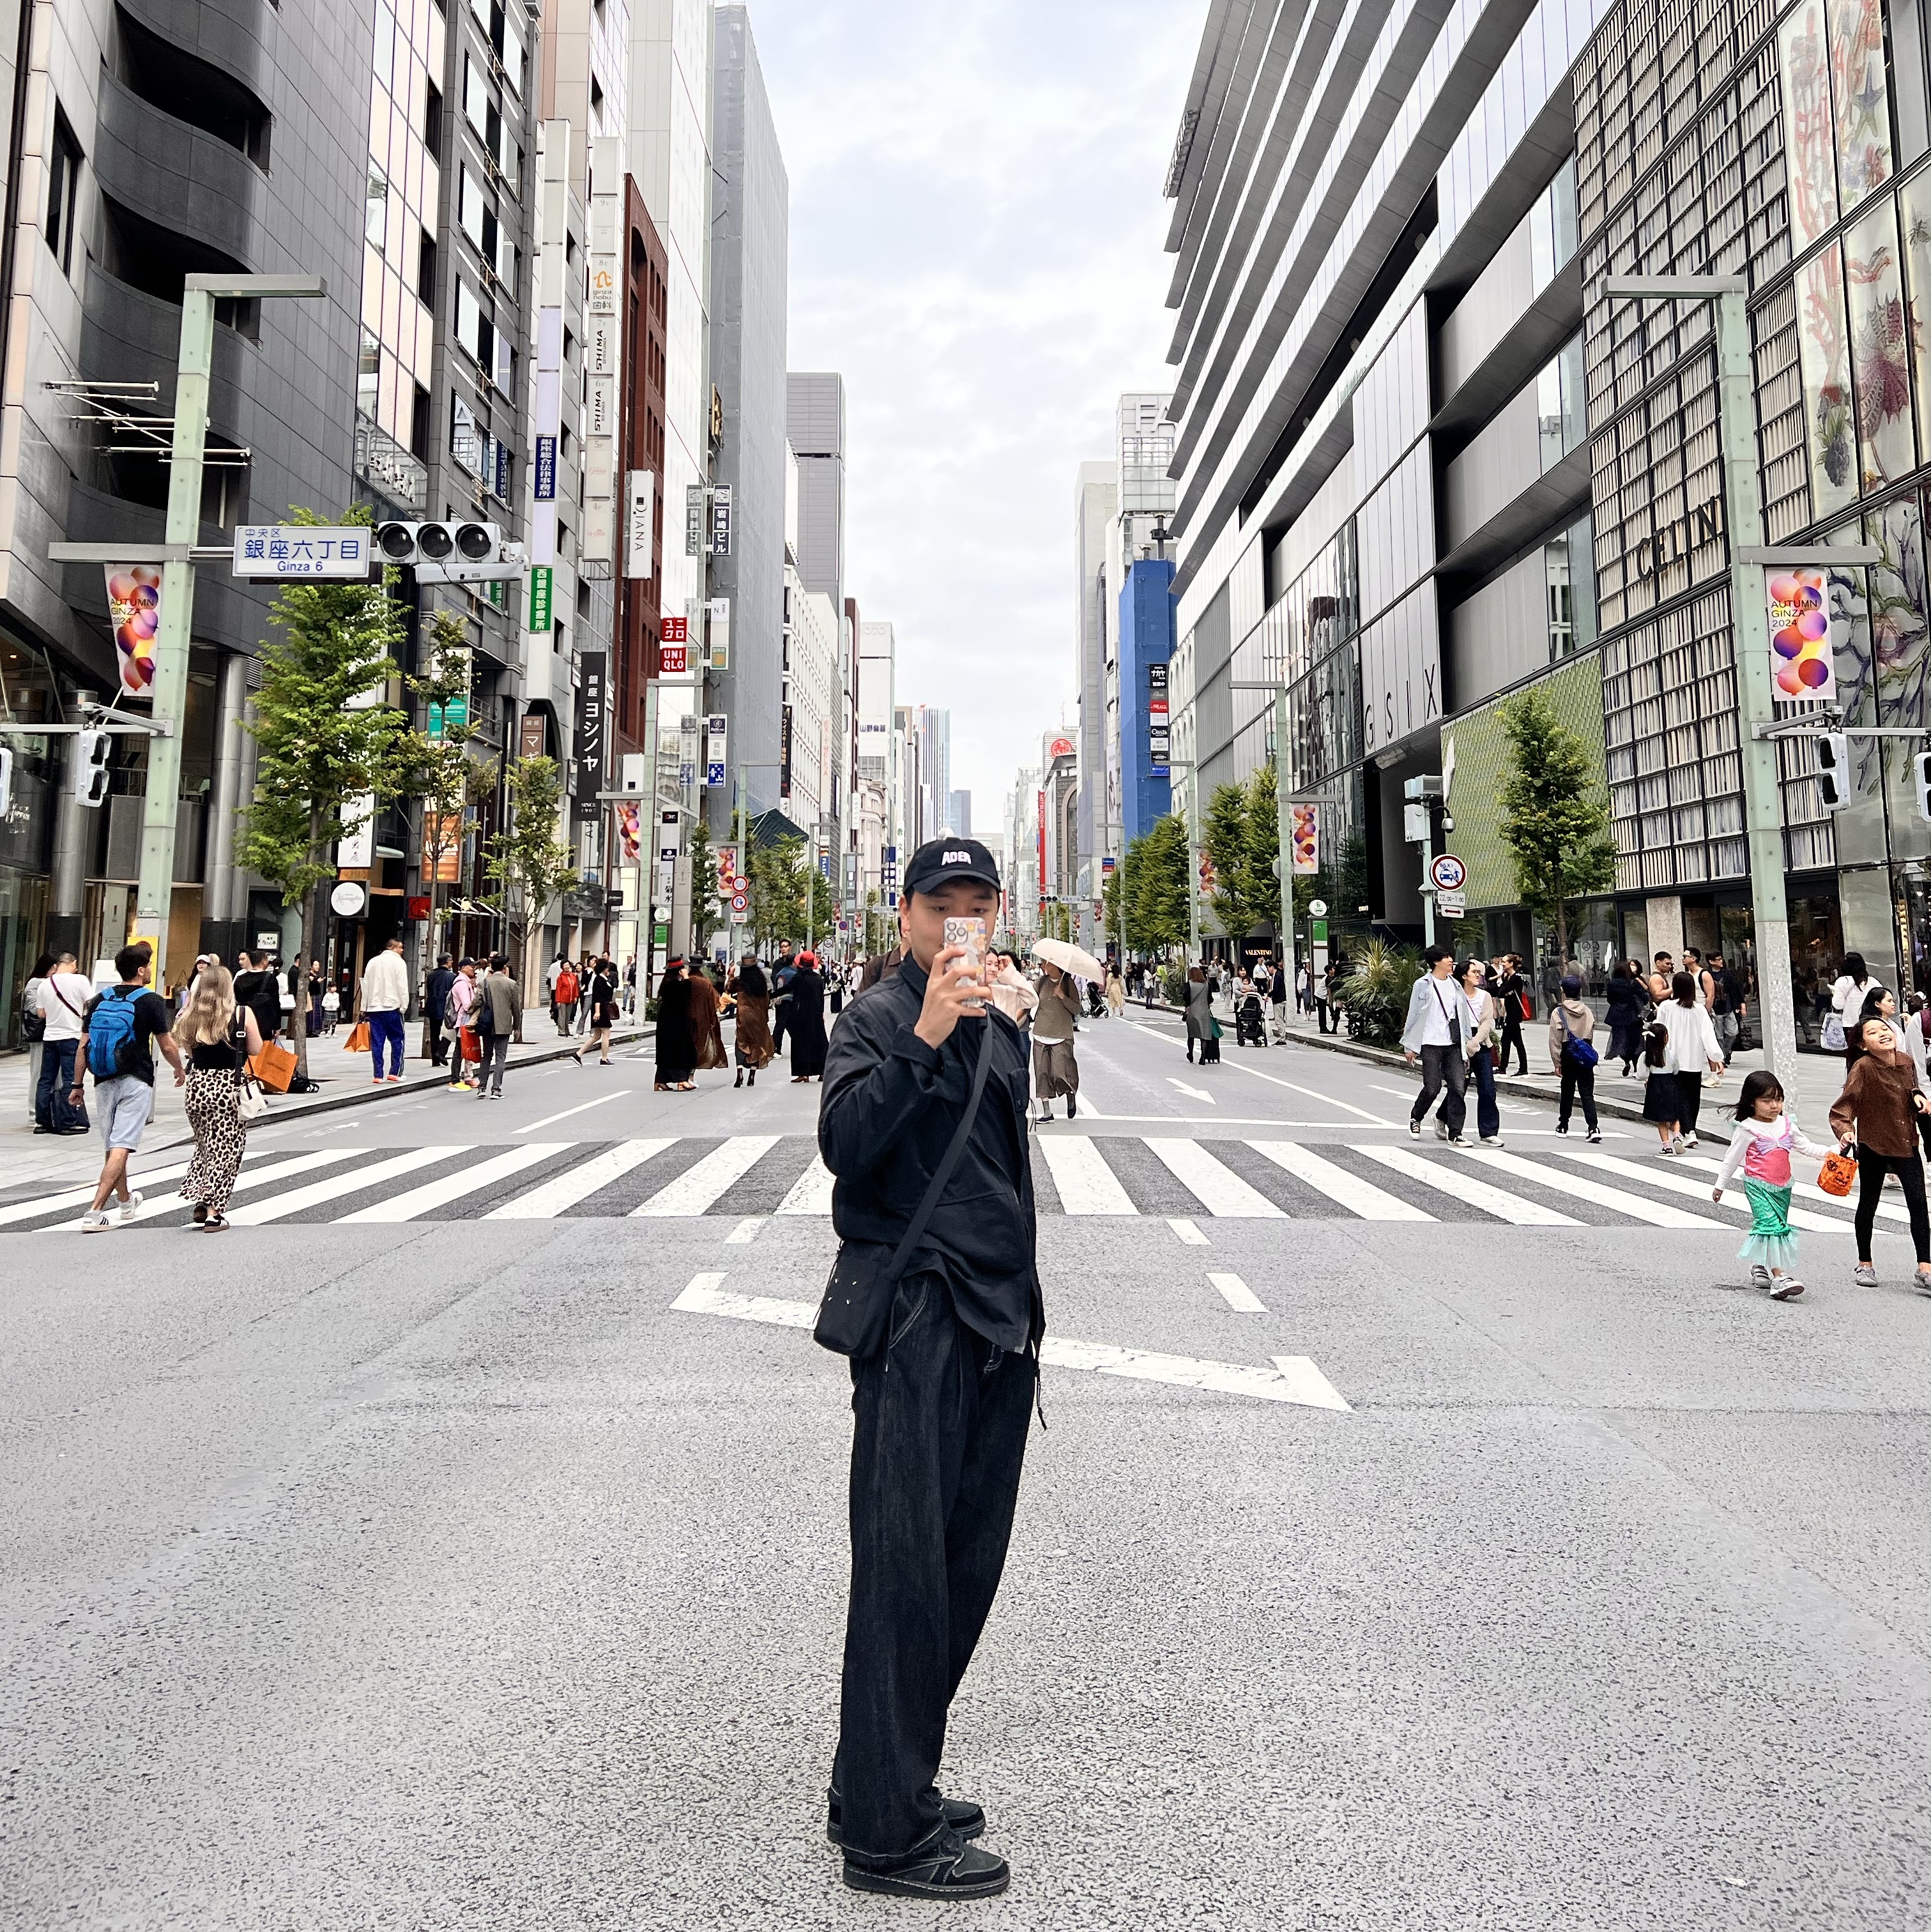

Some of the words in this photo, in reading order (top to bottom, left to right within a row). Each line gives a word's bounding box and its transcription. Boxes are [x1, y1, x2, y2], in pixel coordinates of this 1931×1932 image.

[634, 498, 647, 551] DIANA
[245, 528, 280, 538] 中央区
[715, 509, 727, 553] 岩崎ビル
[1637, 495, 1718, 581] CELIN
[244, 539, 358, 559] 銀座六丁目
[277, 561, 310, 572] Ginza
[316, 561, 323, 572] 6
[110, 598, 154, 607] AUTUMN
[535, 568, 547, 630] 西銀座診療所
[1771, 599, 1818, 609] AUTUMN
[111, 607, 141, 616] GINZA
[1771, 609, 1805, 618] GINZA
[1772, 619, 1797, 627] 2024
[664, 650, 683, 659] UNI
[663, 660, 684, 671] QLO
[941, 851, 972, 866] ADER
